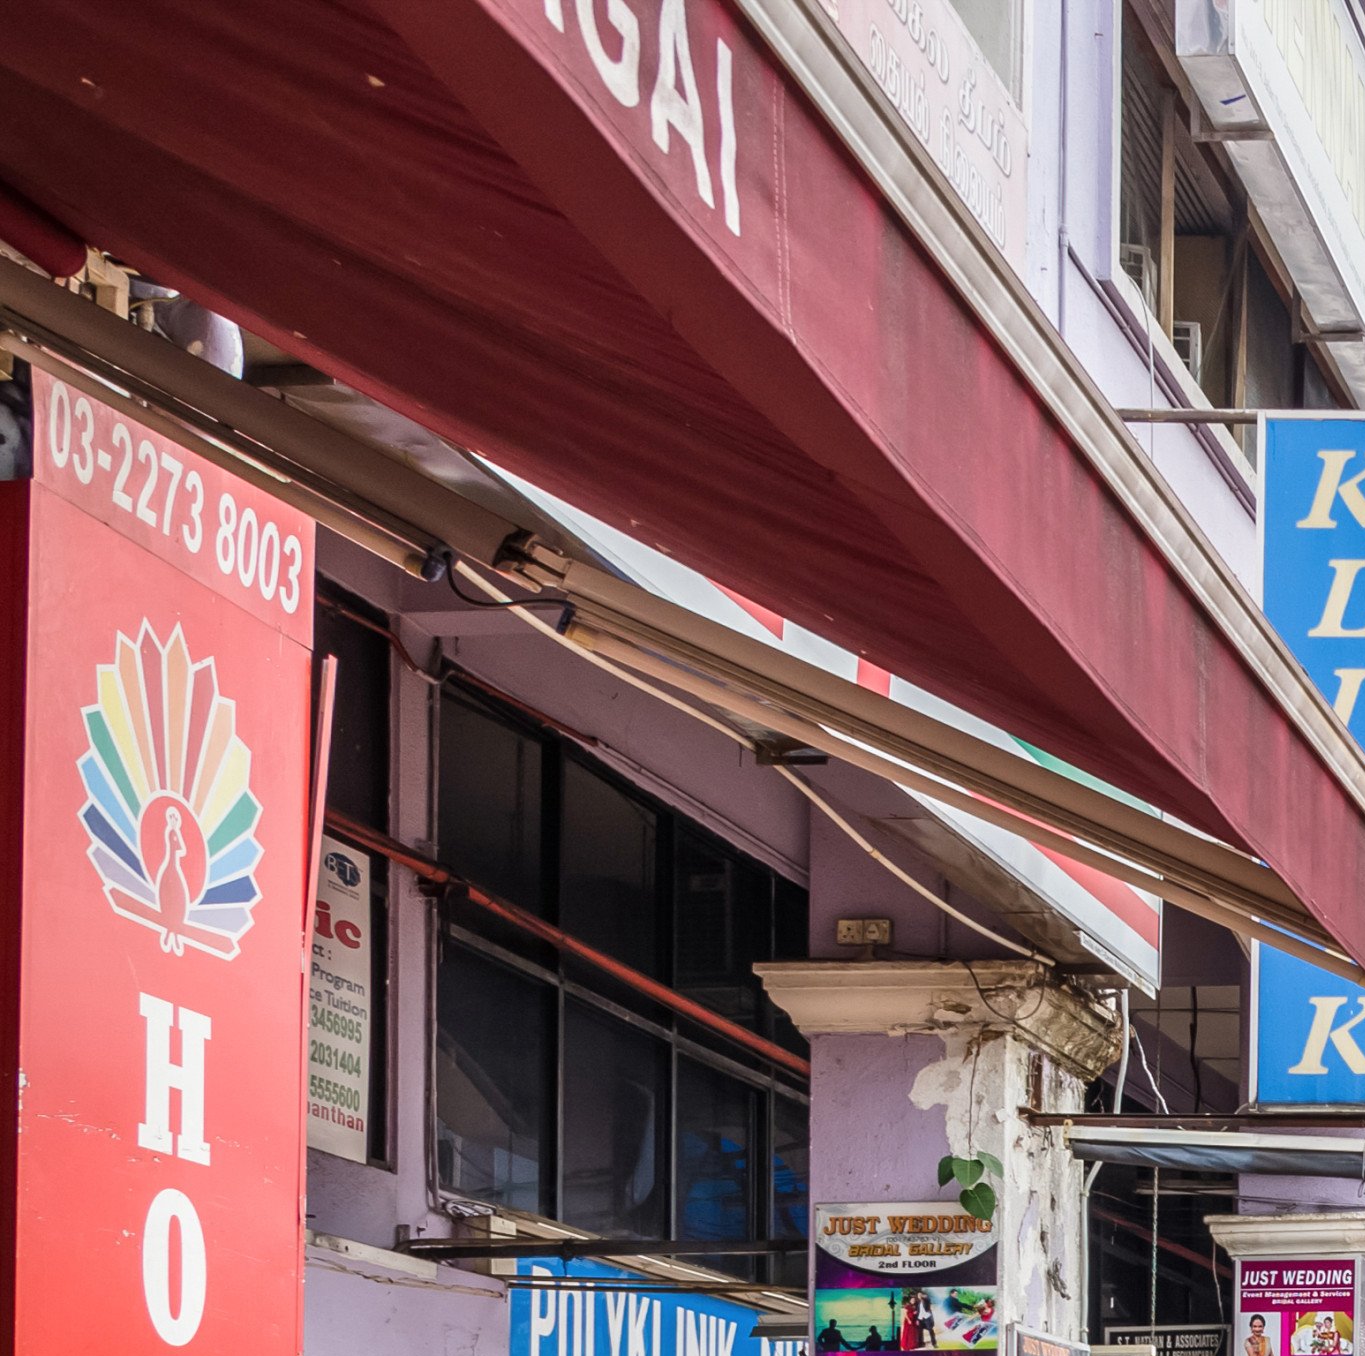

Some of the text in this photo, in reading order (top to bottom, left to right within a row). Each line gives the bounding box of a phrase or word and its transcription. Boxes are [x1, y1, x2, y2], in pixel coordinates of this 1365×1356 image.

[49, 379, 302, 615] 03-2273 8003
[311, 961, 365, 998] Program
[324, 990, 368, 1021] Tuition
[824, 1214, 993, 1236] JUST WEDDING
[848, 1242, 974, 1258] BRIDAL GALLERY
[878, 1260, 937, 1269] 2nd FLOOR
[1242, 1269, 1353, 1286] JUST WEDDING
[1264, 1291, 1311, 1299] Management
[1320, 1290, 1351, 1298] Services
[1175, 1334, 1219, 1347] ASSOCIATES
